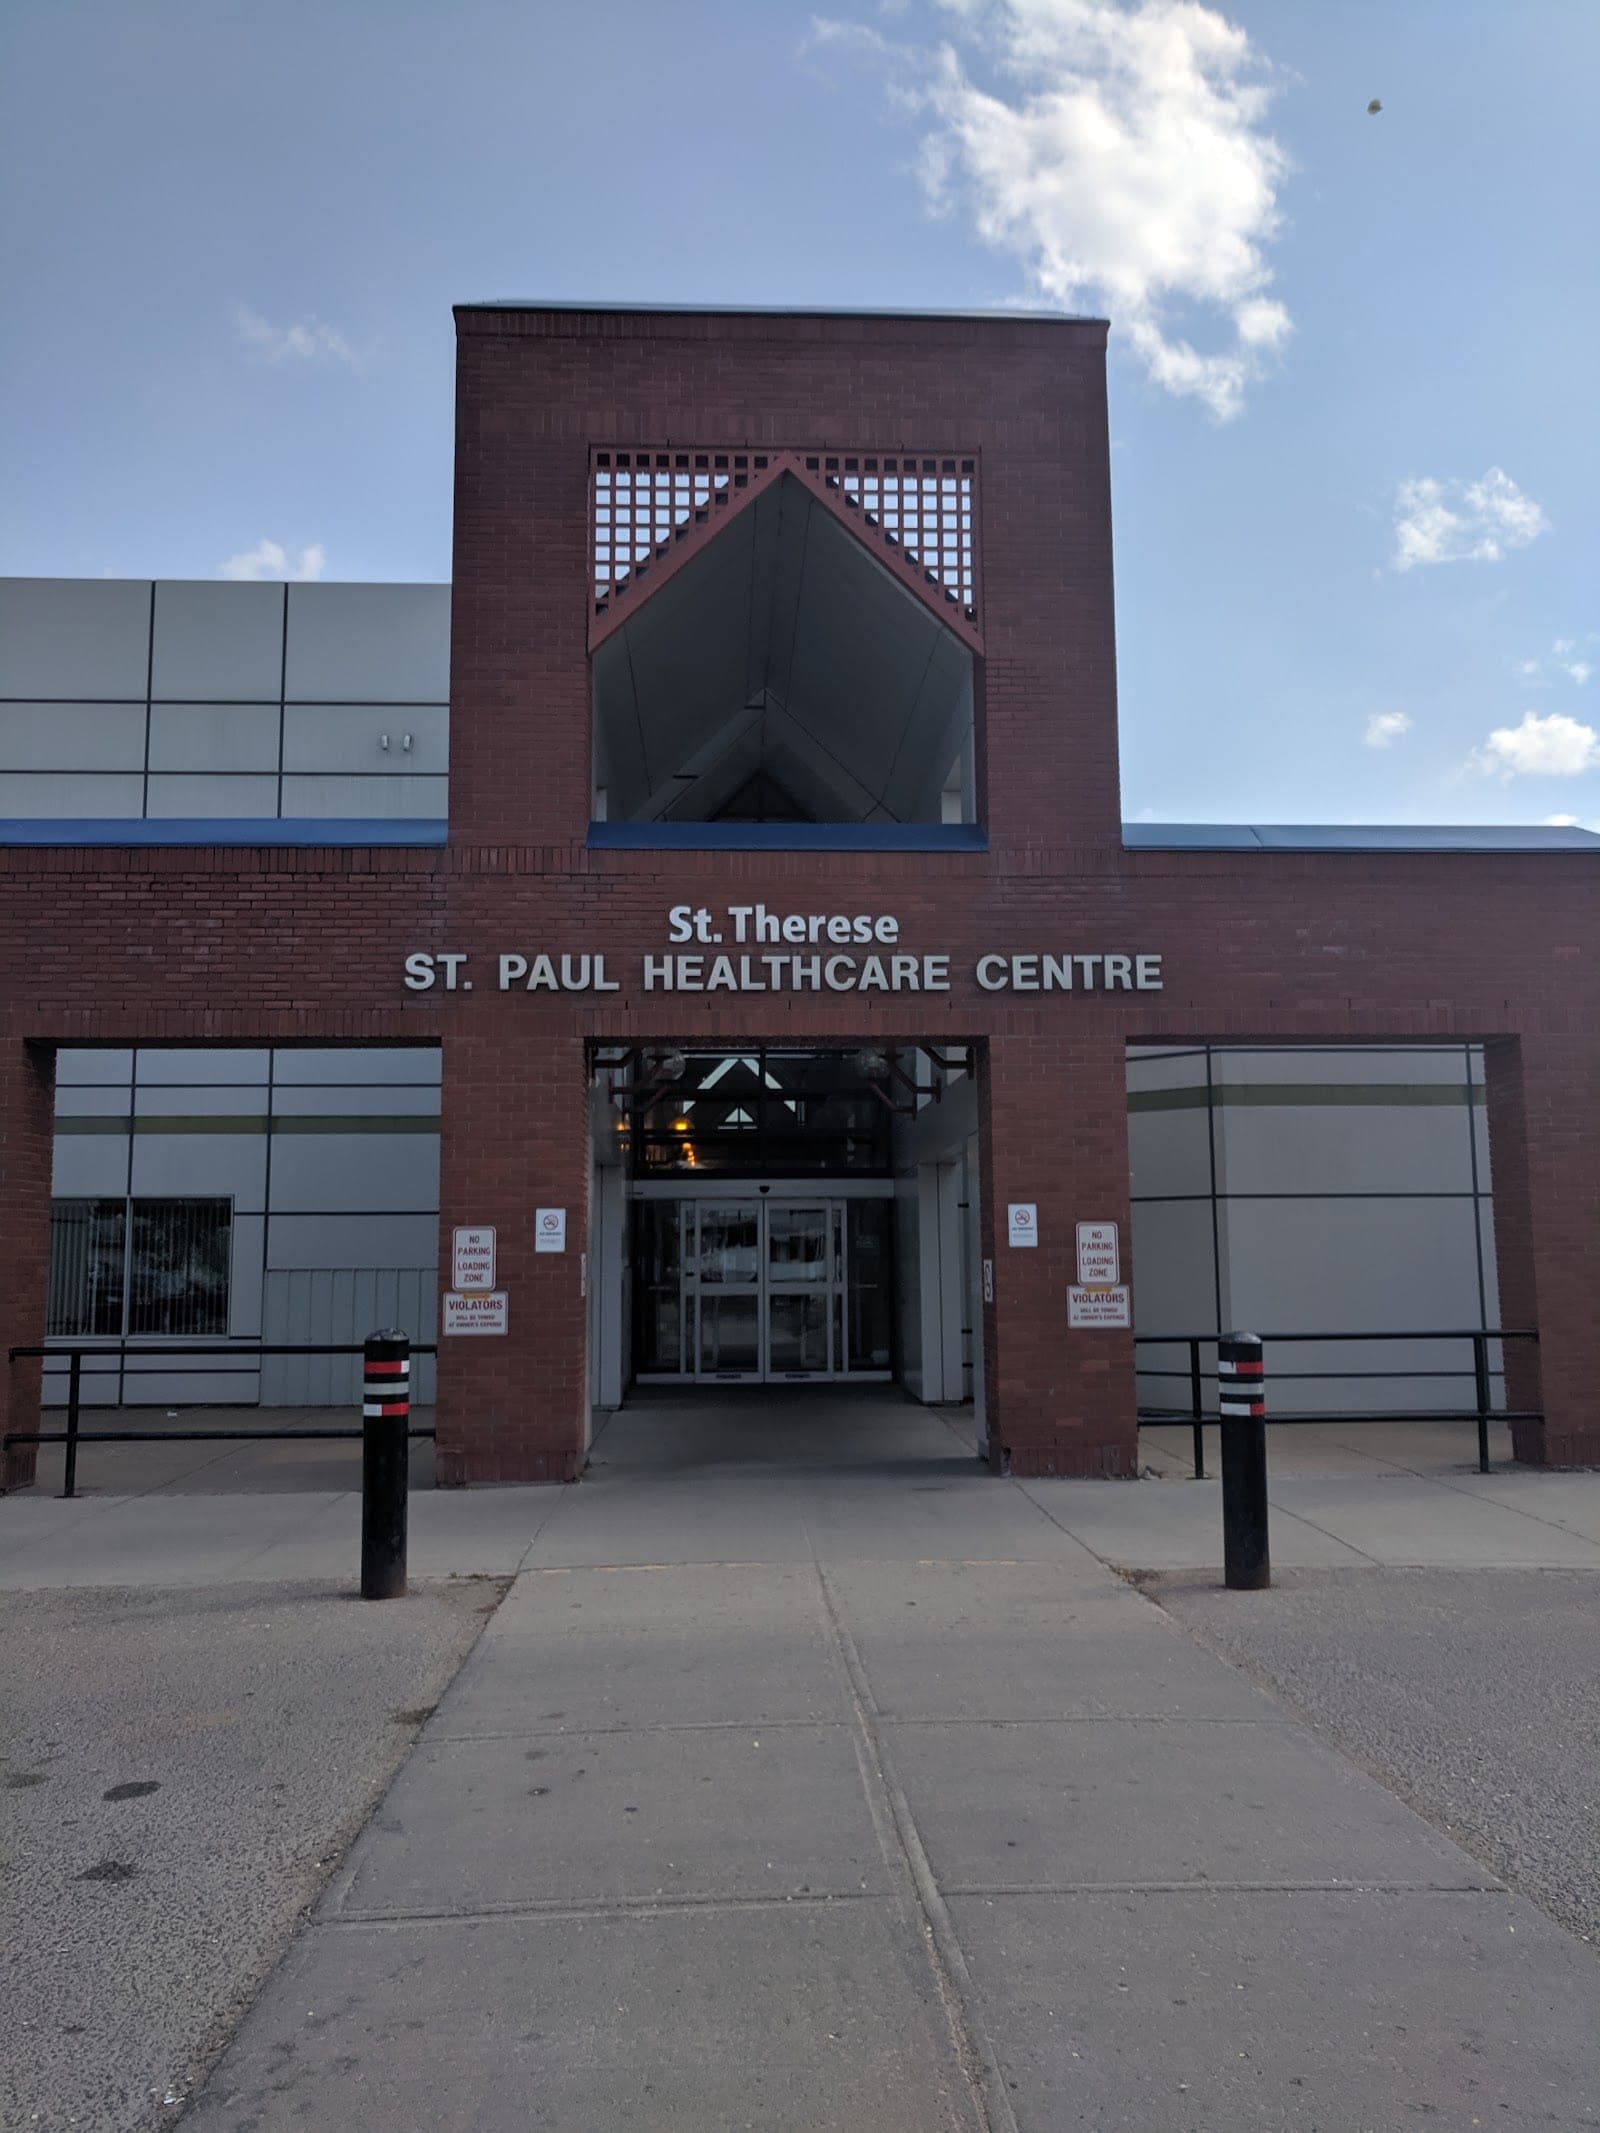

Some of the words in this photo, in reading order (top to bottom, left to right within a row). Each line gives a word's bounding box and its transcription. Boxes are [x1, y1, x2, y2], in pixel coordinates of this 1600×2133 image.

[669, 905, 723, 943] St.
[727, 904, 899, 944] Therese
[404, 953, 473, 990] ST.
[499, 954, 620, 991] PAUL
[644, 954, 951, 991] HEALTHCARE
[976, 954, 1164, 991] CENTRE
[469, 1235, 480, 1244] NO
[1092, 1231, 1102, 1239] NO
[458, 1246, 490, 1255] PARKING
[1082, 1242, 1113, 1250] PARKING
[1082, 1257, 1114, 1265] LOADING
[458, 1261, 490, 1271] LOADING
[1089, 1268, 1107, 1277] ZONE
[463, 1273, 484, 1283] ZONE
[1072, 1293, 1125, 1304] VIOLATORS
[449, 1300, 503, 1311] VIOLATORS
